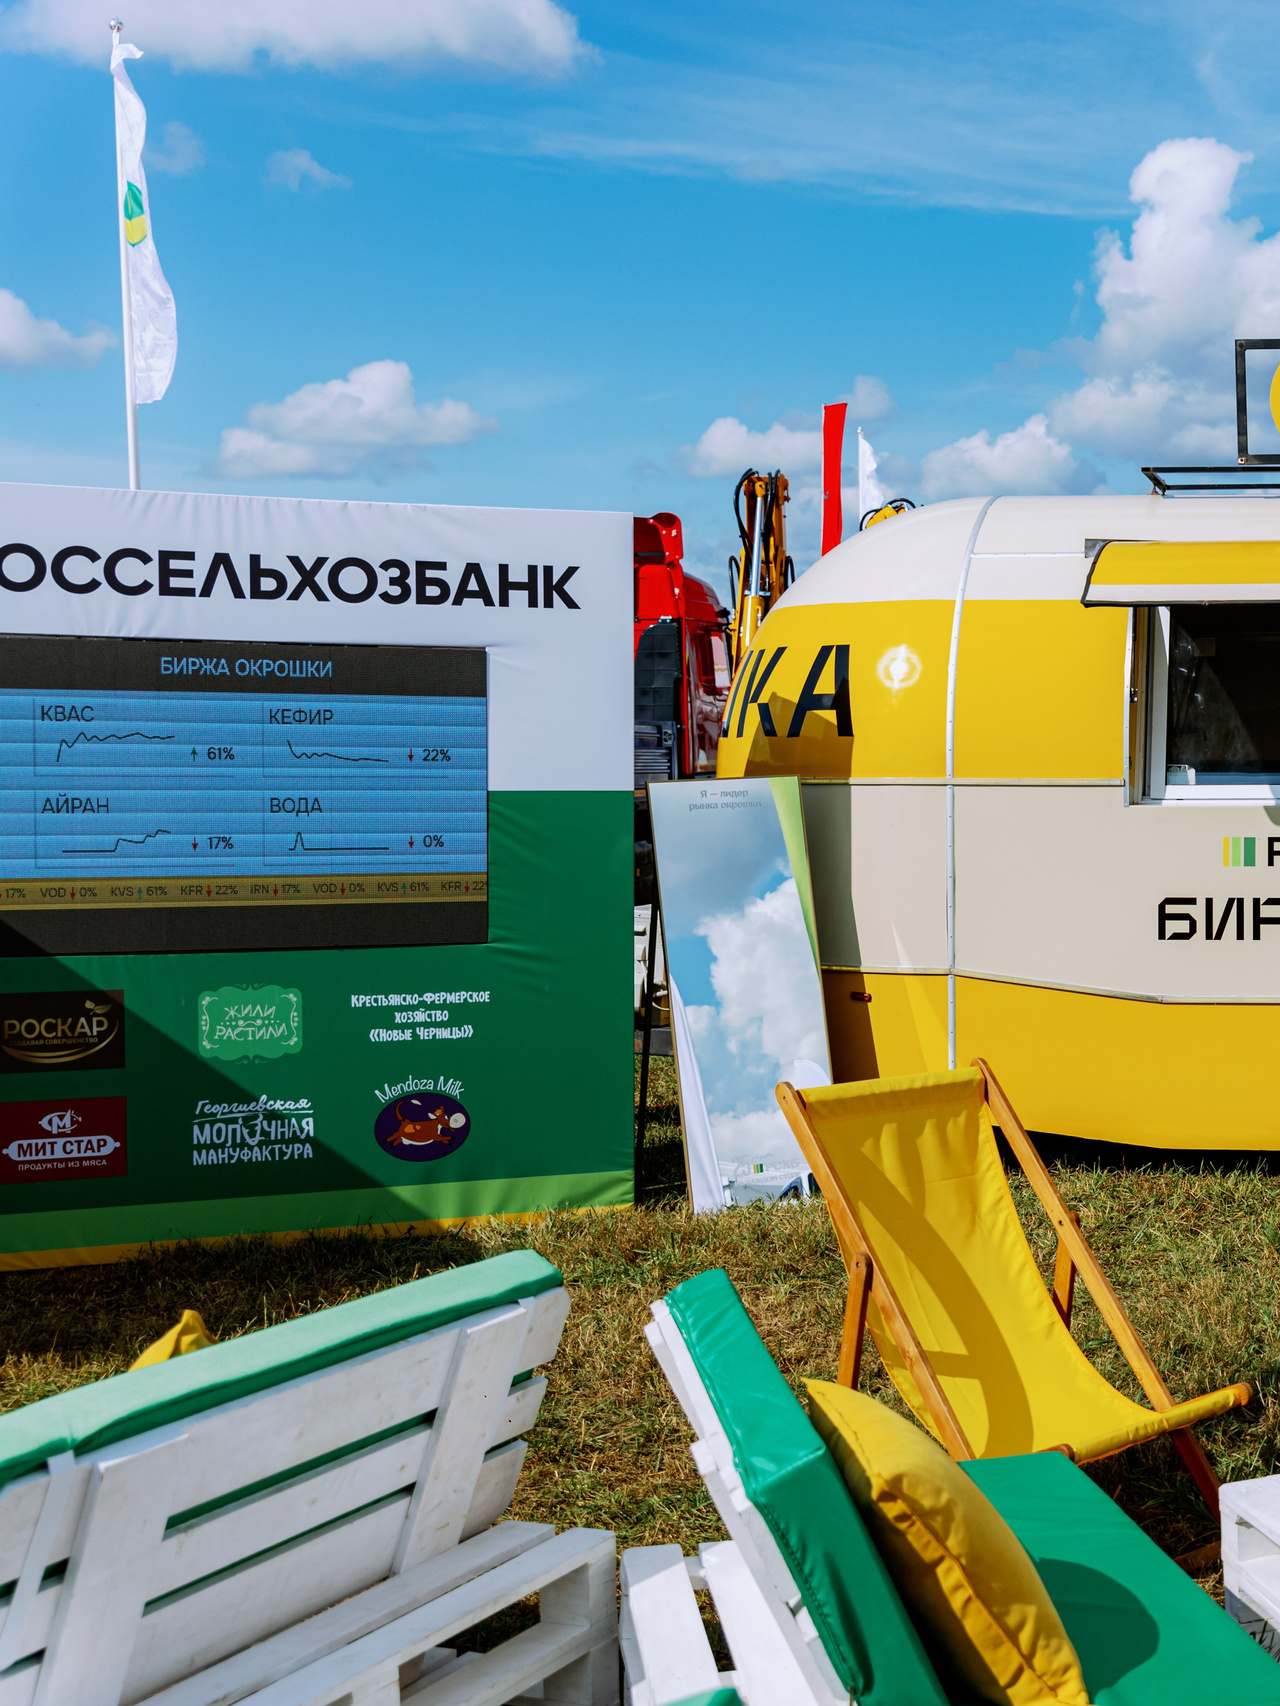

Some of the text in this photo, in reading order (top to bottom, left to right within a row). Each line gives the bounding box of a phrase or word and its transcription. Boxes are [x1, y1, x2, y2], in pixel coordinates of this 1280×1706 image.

[0, 542, 581, 610] ОССЕЛЬХОЗБАНК
[160, 656, 332, 678] БИРЖА ОКРОШКИ
[721, 644, 854, 738] КА
[41, 705, 94, 723] КВАС
[269, 707, 333, 726] КЕФИР
[207, 746, 235, 761] 61%
[422, 748, 451, 764] 22%
[720, 790, 748, 799] лидер
[41, 794, 109, 815] АЙРАН
[270, 797, 322, 817] ВОДА
[689, 801, 761, 812] рынка окрошки
[207, 835, 234, 850] 17%
[423, 834, 444, 849] 0%
[5, 888, 26, 899] 17%
[40, 887, 66, 898] VOD
[79, 887, 97, 897] 0%
[110, 886, 134, 897] KVS
[146, 885, 168, 896] 61%
[180, 885, 203, 895] KFR
[215, 884, 238, 895] 22%
[250, 884, 270, 894] IRN
[281, 883, 301, 894] 17%
[312, 883, 337, 893] VOD
[349, 882, 365, 893] 0%
[377, 882, 398, 892] KVS
[410, 881, 429, 892] 61%
[441, 881, 462, 891] KFR
[224, 1004, 276, 1020] ЖИЛИ
[4, 1016, 108, 1039] РОСКАР
[214, 1023, 288, 1041] РАСТИЛИ
[374, 1075, 465, 1103] Mendoza Milk
[17, 1138, 108, 1158] МИТ СТАР
[193, 1143, 313, 1166] МАНУФАКТУРА
[18, 1159, 107, 1172] ПРОДУКТЫ ИЗ МЯСА
